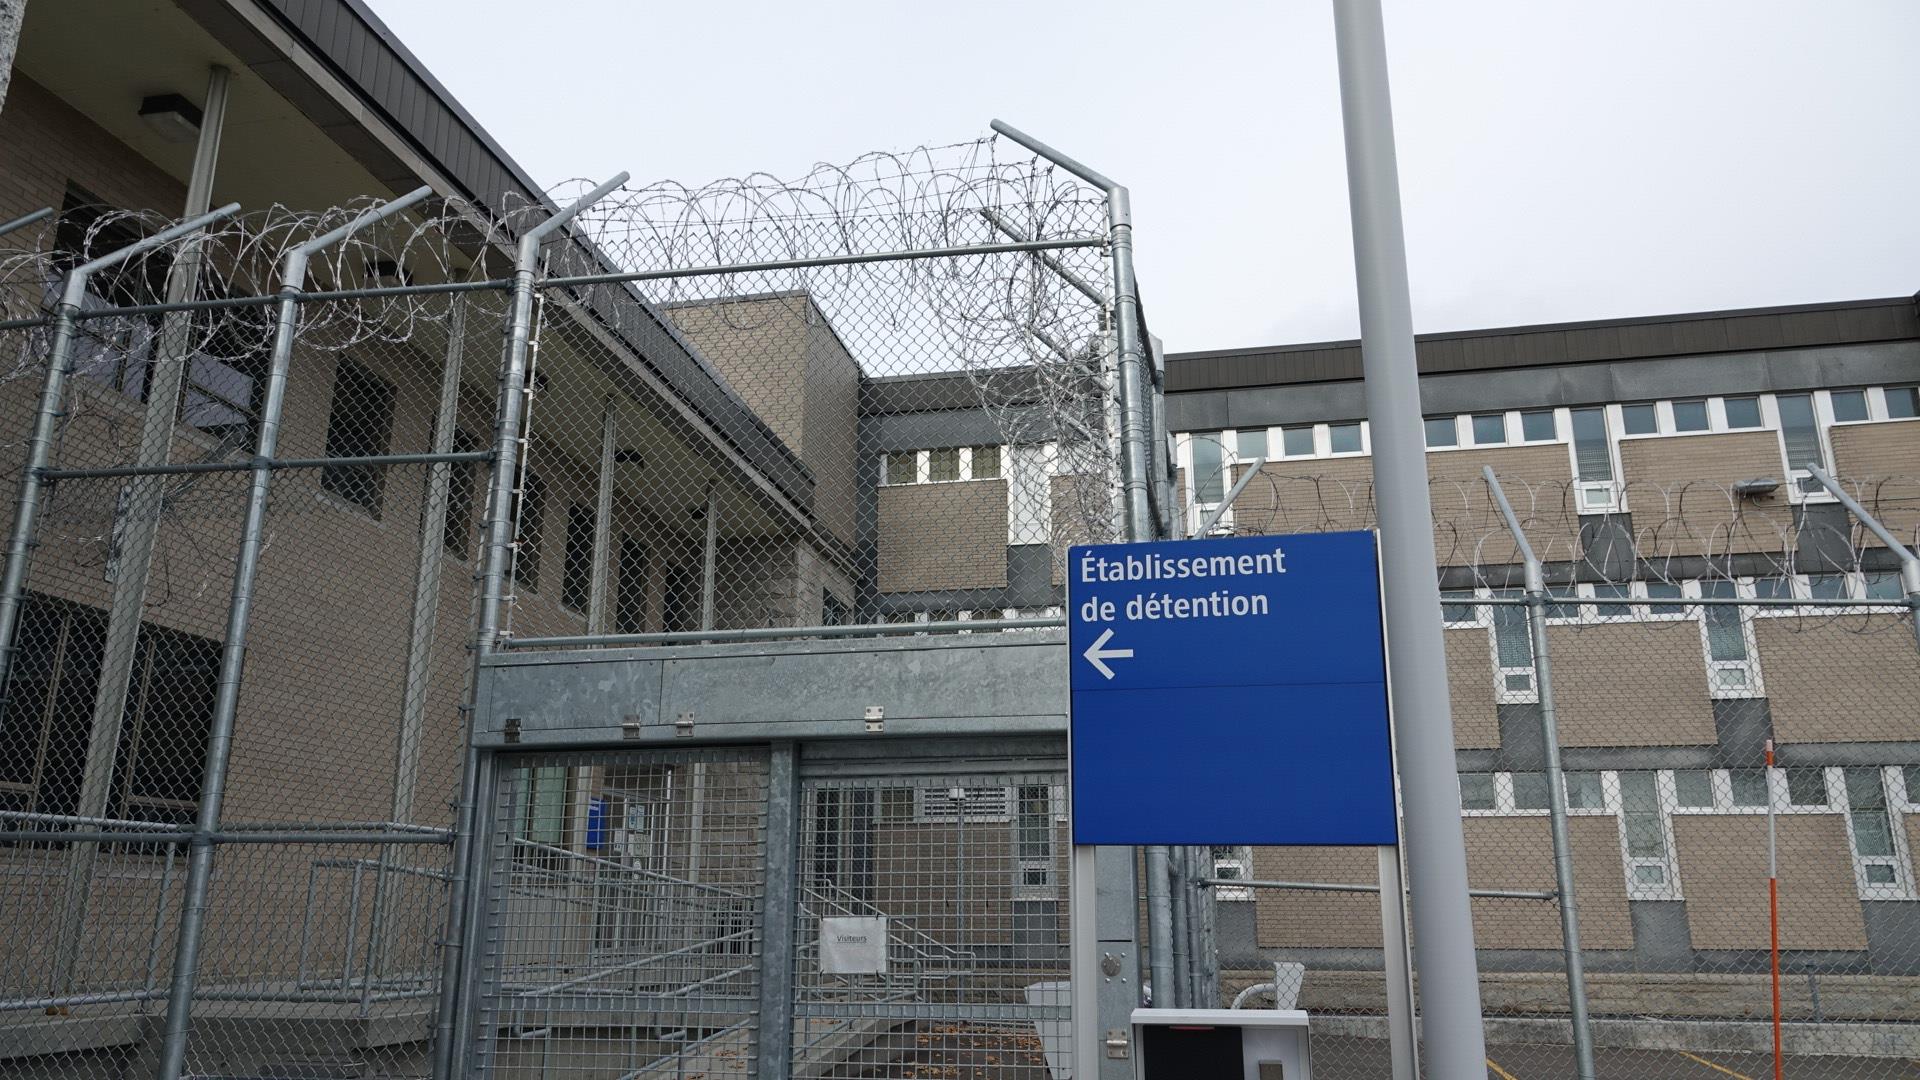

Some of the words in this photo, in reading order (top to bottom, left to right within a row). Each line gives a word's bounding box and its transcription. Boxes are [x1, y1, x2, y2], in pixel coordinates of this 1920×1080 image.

[1081, 548, 1286, 582] Établissement
[1081, 597, 1116, 622] de
[1126, 590, 1269, 620] détention
